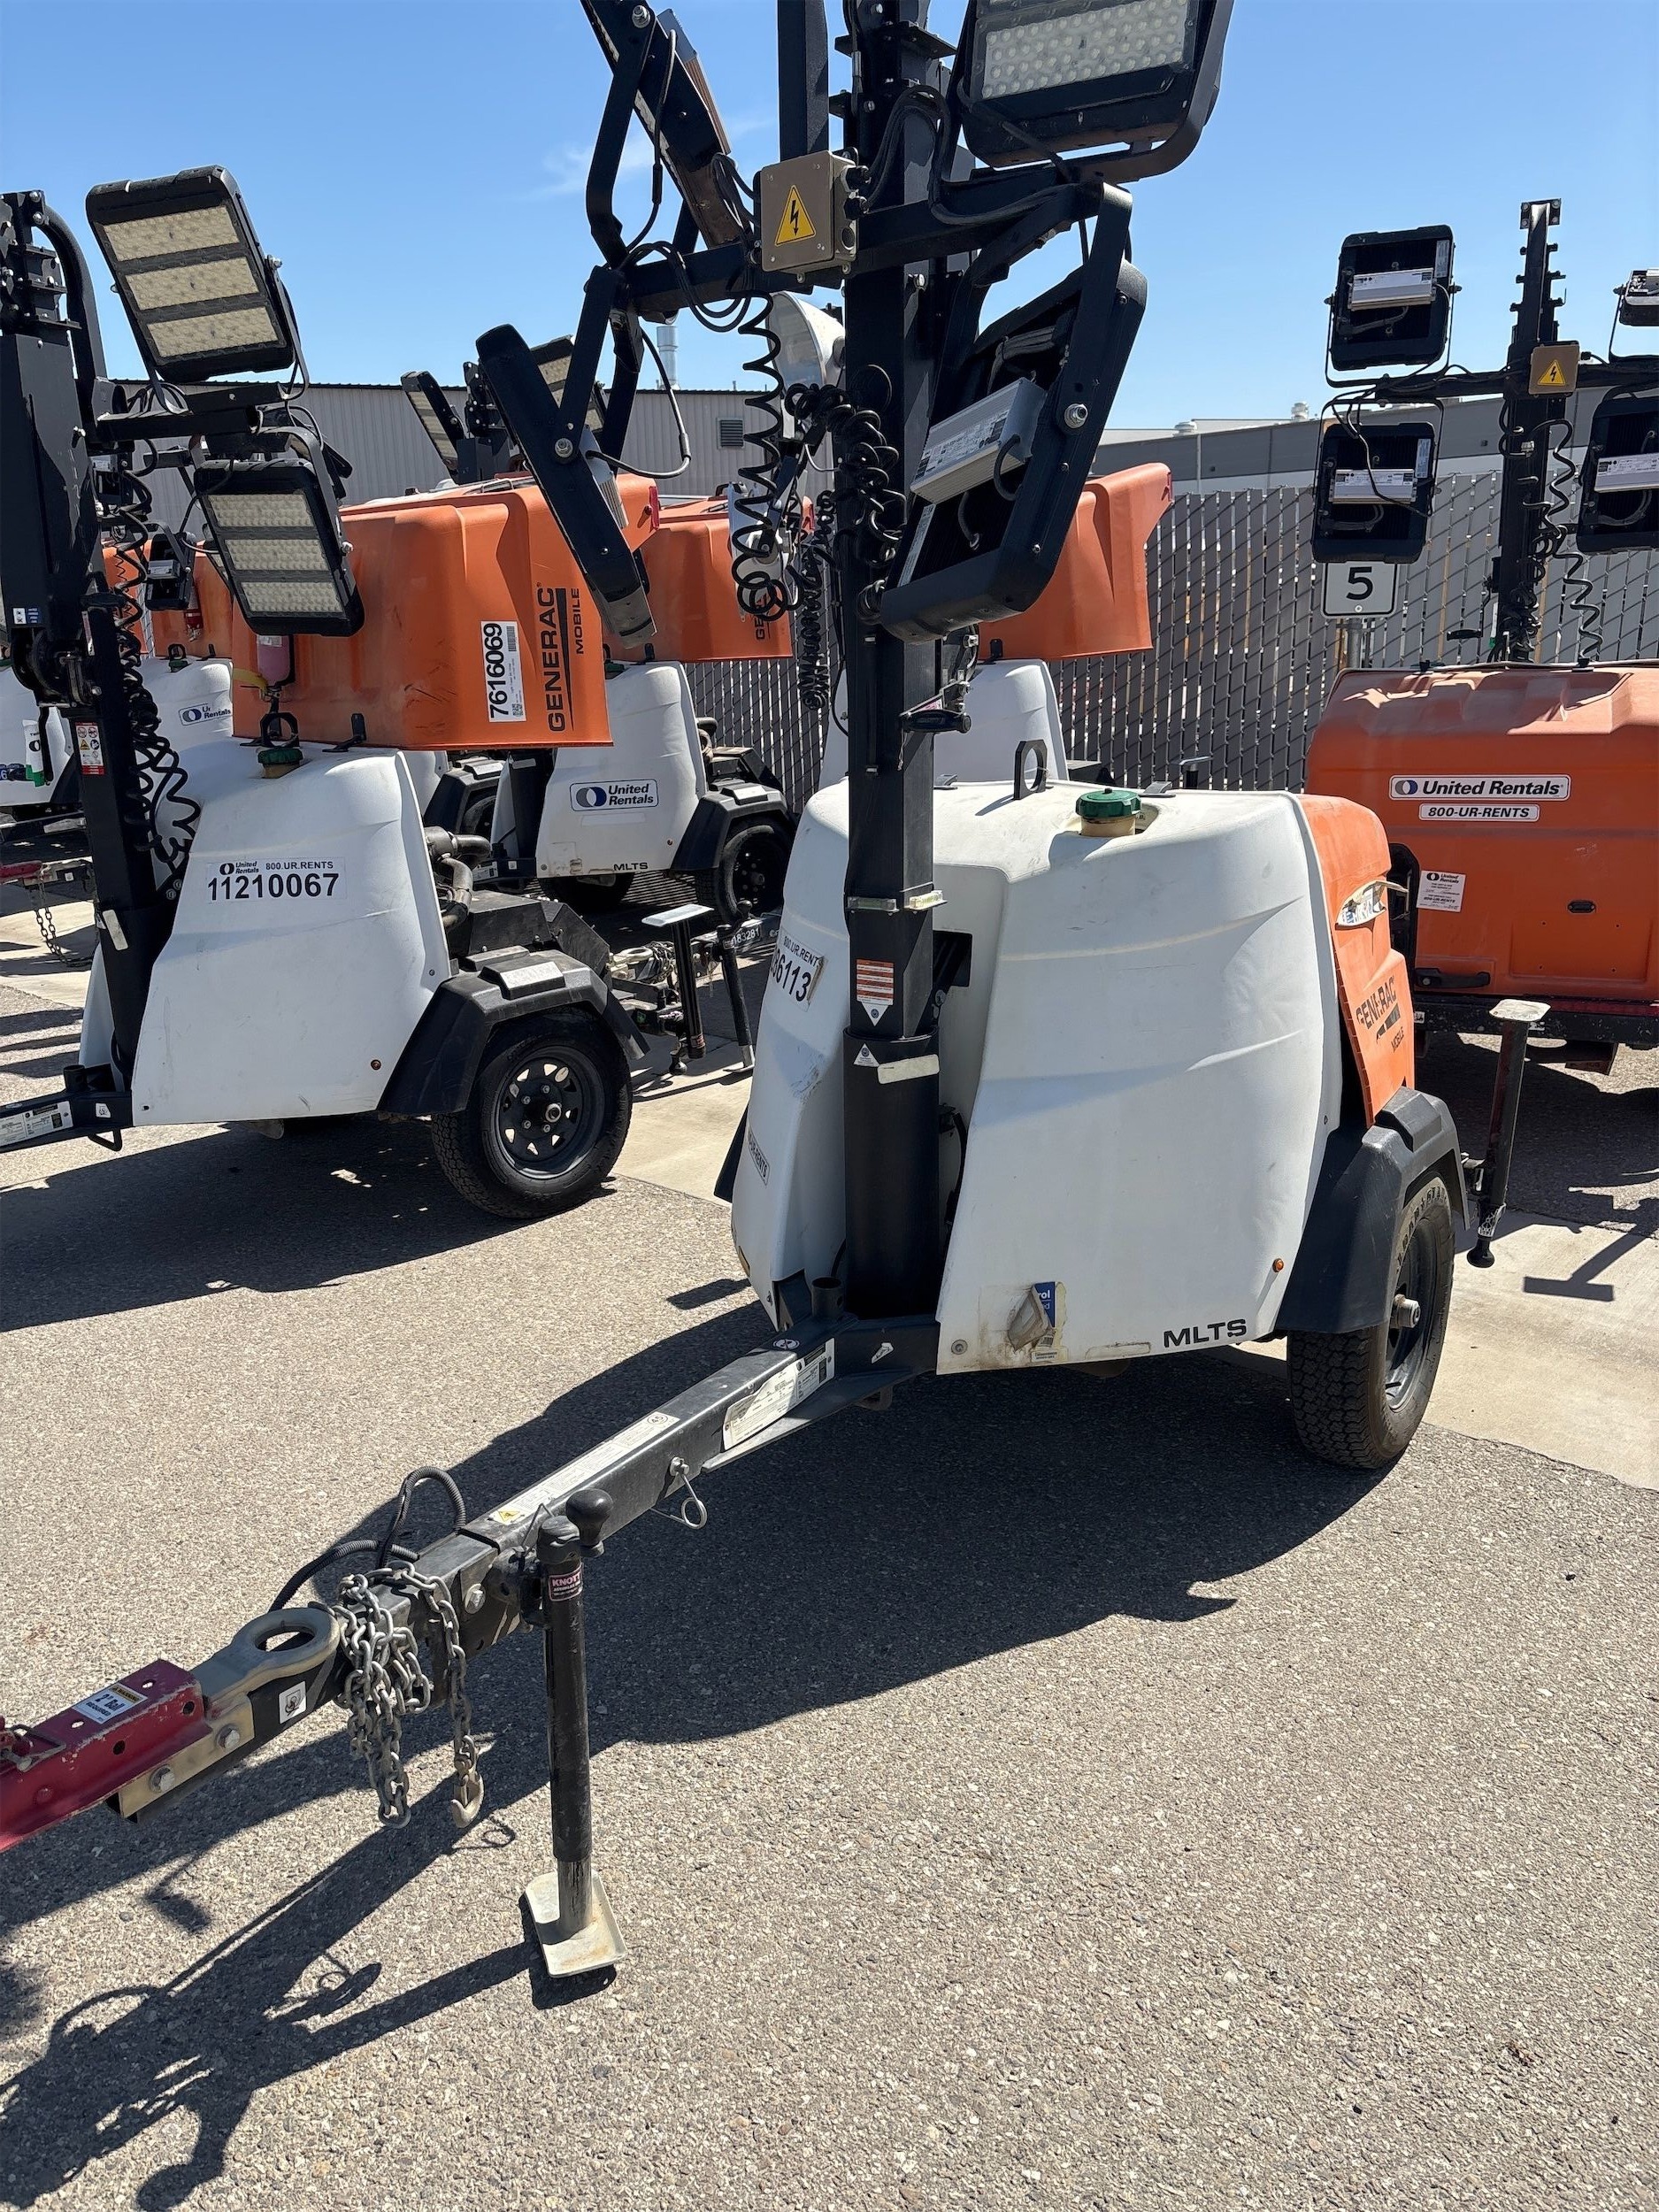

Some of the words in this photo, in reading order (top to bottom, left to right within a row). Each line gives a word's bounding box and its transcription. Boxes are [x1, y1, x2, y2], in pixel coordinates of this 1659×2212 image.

[1346, 566, 1373, 600] 5
[571, 588, 584, 654] MOBILE
[483, 623, 509, 718] 7616069
[537, 588, 565, 732] GENERAC
[608, 784, 649, 795] United
[1423, 780, 1486, 795] United
[1488, 780, 1560, 795] Rentals
[609, 795, 654, 805] Rentals
[1428, 807, 1530, 818] 800-UR-RENTS
[265, 861, 334, 870] 800.UR.RENTS
[613, 862, 649, 871] MLTS
[208, 873, 339, 901] 11210067
[1163, 1318, 1248, 1348] MLTS
